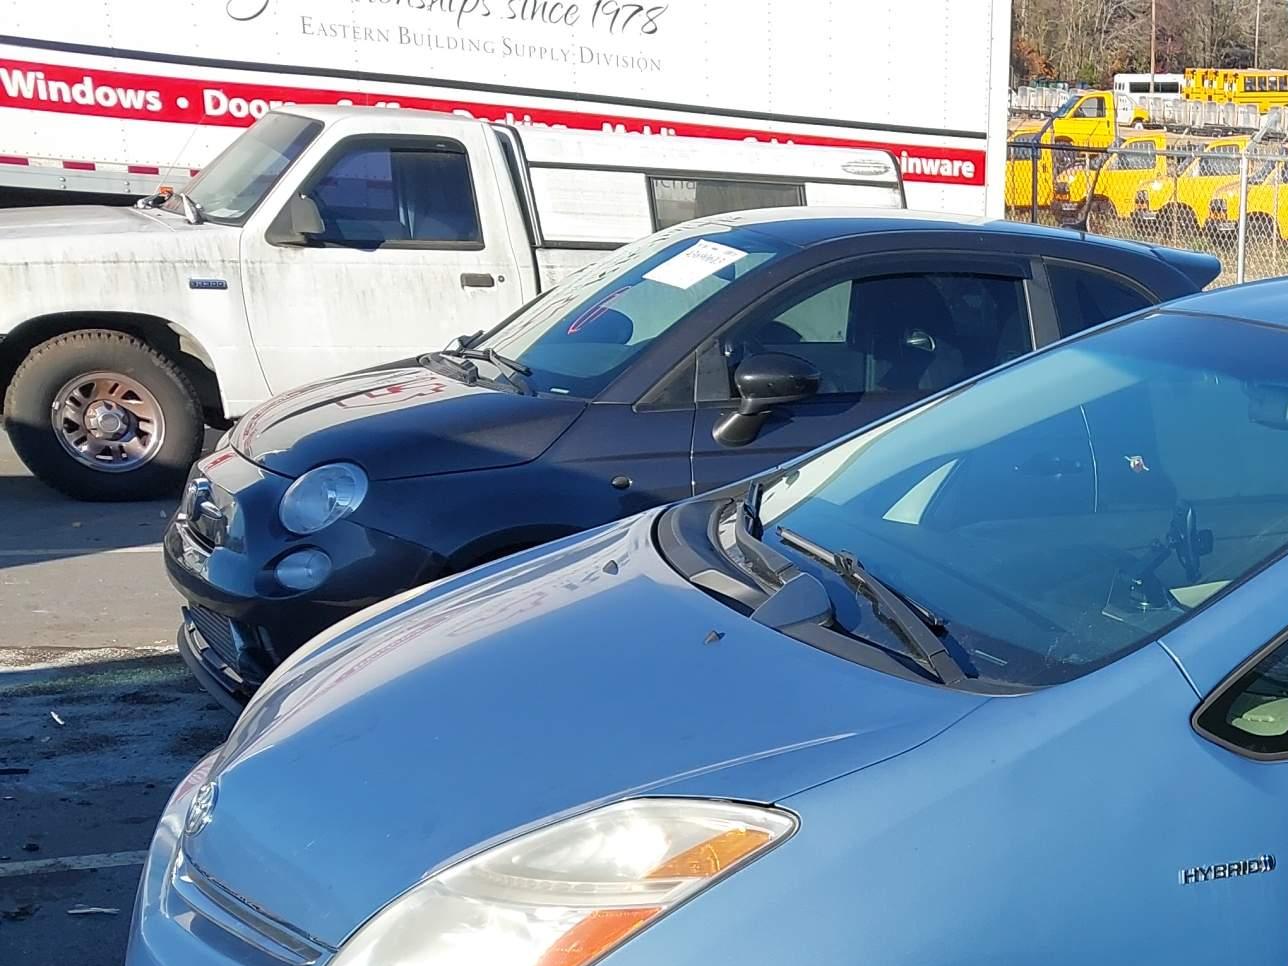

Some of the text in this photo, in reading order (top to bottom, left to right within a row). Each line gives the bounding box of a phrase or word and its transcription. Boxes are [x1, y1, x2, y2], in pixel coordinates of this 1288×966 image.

[300, 15, 662, 72] EASTERN BUILDING SUPPLY DIVISION
[507, 0, 580, 26] since
[591, 0, 669, 35] 1978
[0, 67, 163, 112] Windows
[896, 150, 976, 179] inware
